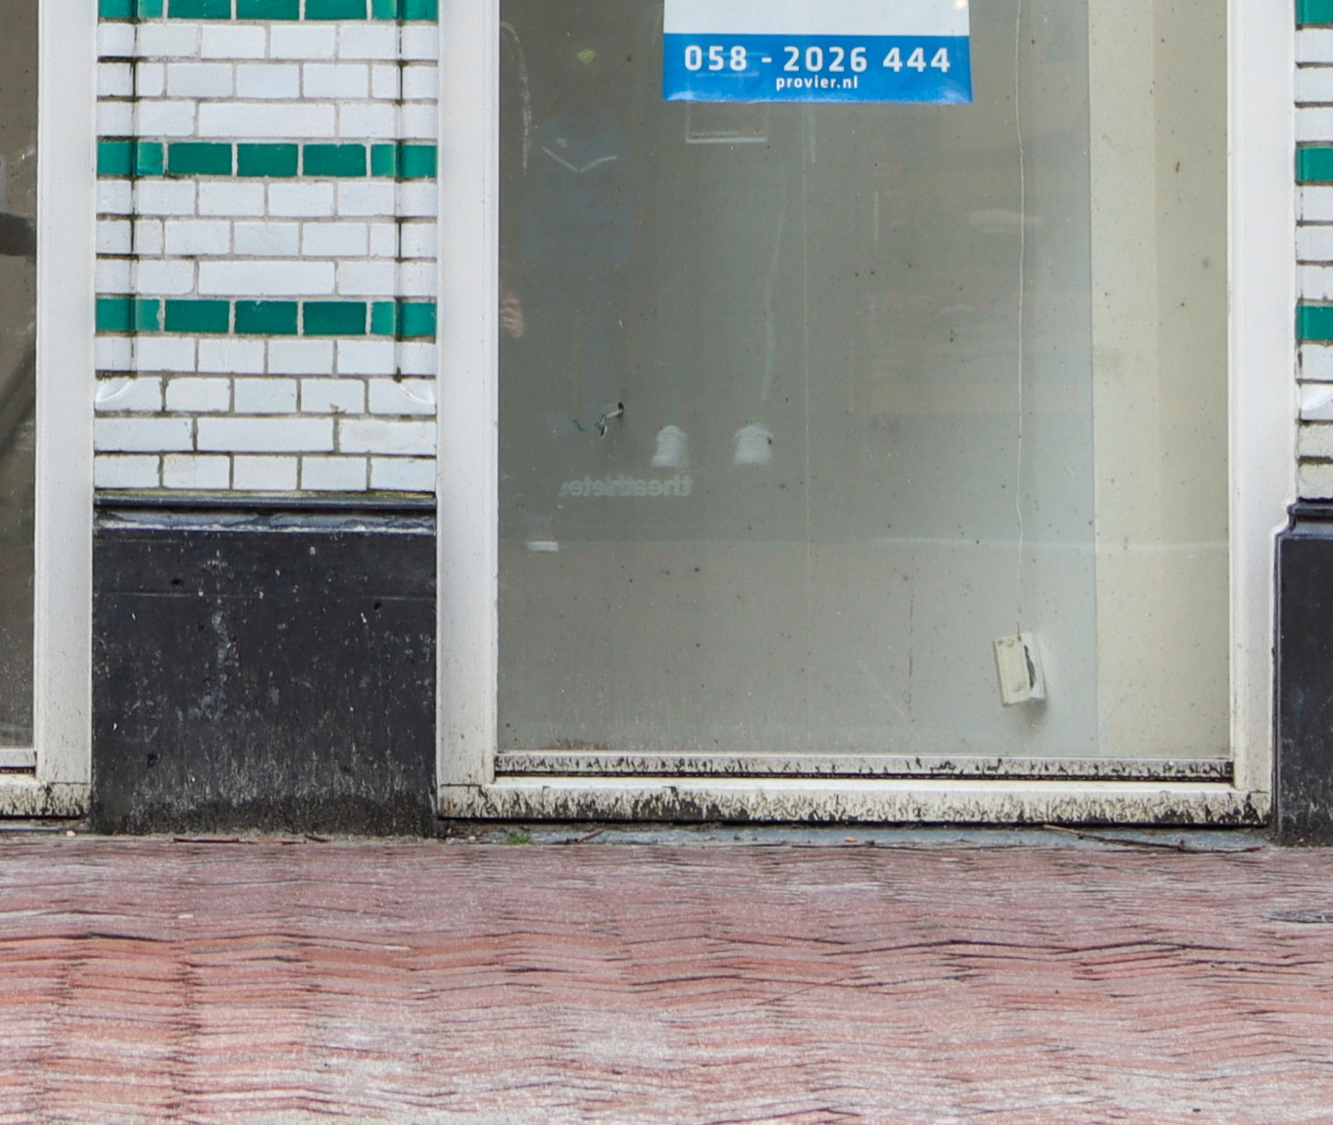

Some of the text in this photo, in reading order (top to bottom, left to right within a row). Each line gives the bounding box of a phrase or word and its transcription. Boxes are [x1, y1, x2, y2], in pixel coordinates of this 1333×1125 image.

[684, 44, 748, 72] 058
[783, 45, 869, 73] 2026
[882, 46, 951, 74] 444
[775, 74, 859, 91] provier.nl
